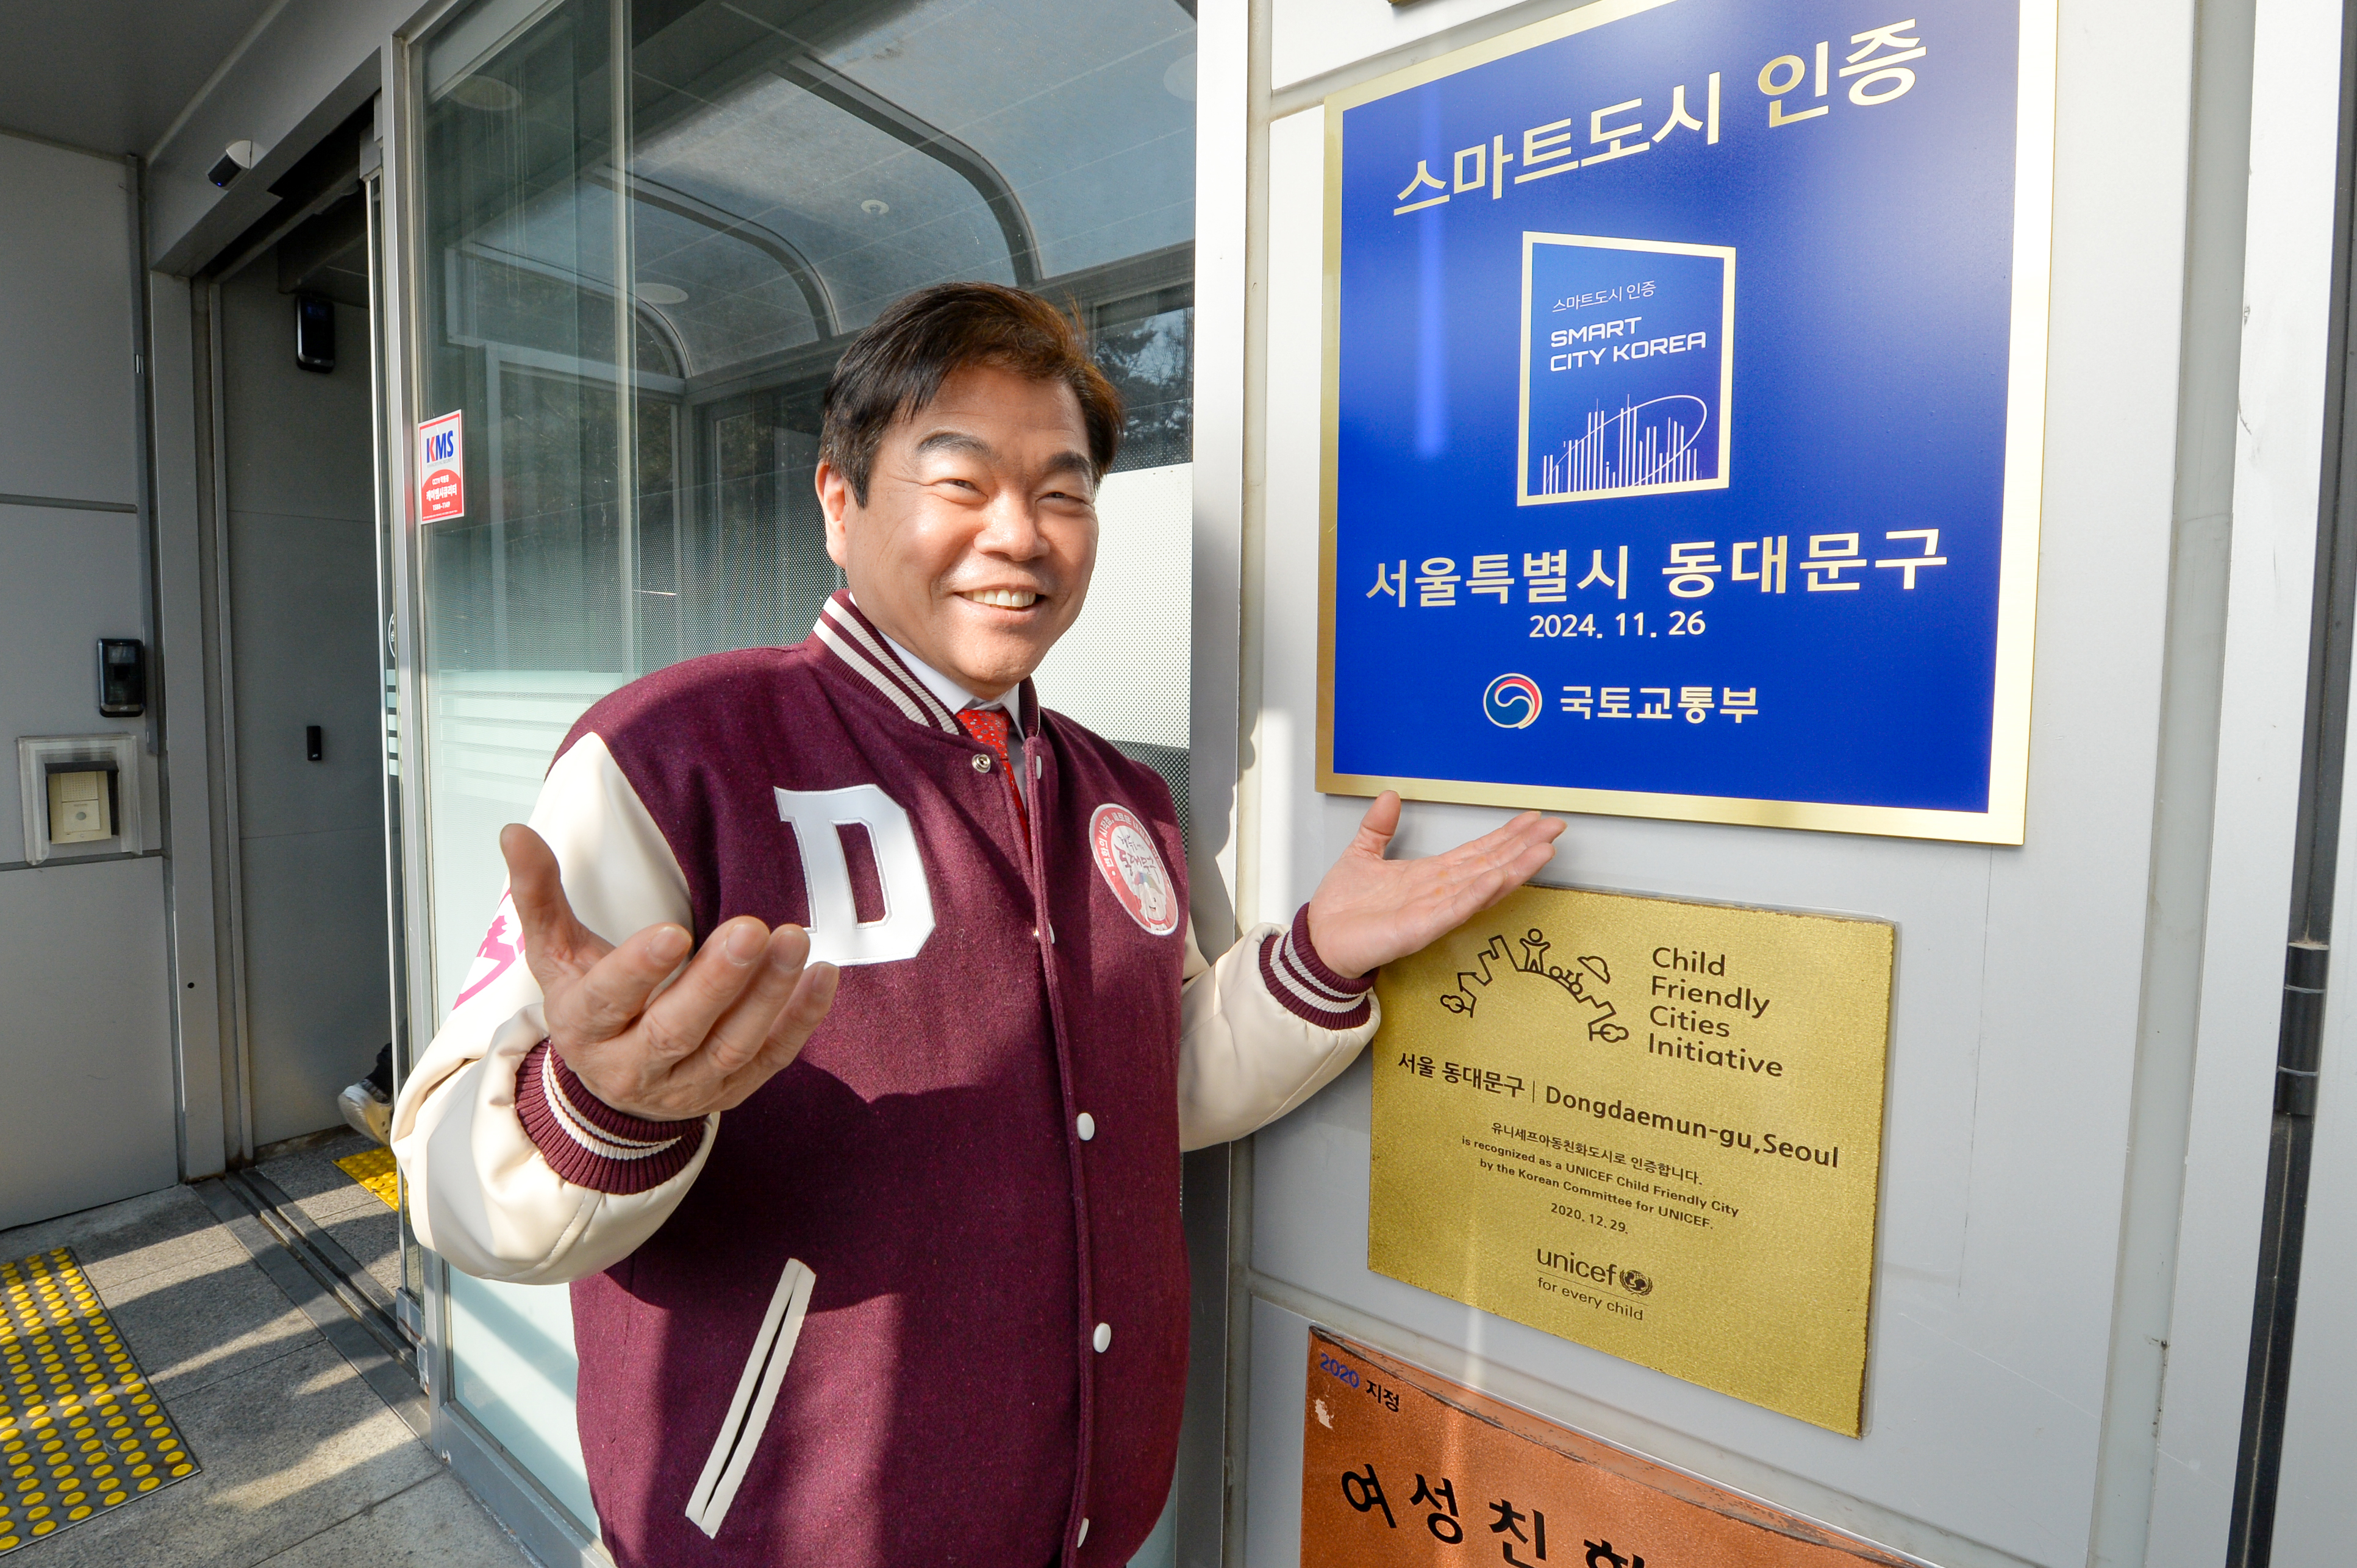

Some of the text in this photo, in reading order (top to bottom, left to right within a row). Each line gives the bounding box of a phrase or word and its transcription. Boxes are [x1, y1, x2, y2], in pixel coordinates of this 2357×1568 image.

[1393, 18, 1927, 216] 스마트도시 인증
[1552, 280, 1656, 312] 스마트도시 인증
[1550, 331, 1706, 372] CITY KOREA
[1551, 316, 1642, 347] SMART
[427, 430, 454, 463] KMS
[1365, 529, 1947, 608] 서울특별시 동대문구
[1529, 610, 1706, 639] 2024. 11. 26
[1560, 686, 1759, 724] 국토교통부
[773, 784, 936, 969] D
[1652, 946, 1726, 977] Child
[1651, 976, 1770, 1019] Friendly
[1650, 1005, 1730, 1037] Cities
[1398, 1052, 1436, 1078] 서울
[1442, 1061, 1525, 1099] 동대문구
[1648, 1033, 1784, 1077] Initiative
[1491, 1122, 1703, 1186] 유니세프아동친화도시로 인증합니다.
[1462, 1136, 1471, 1146] is
[1474, 1140, 1535, 1163] recognized
[1539, 1158, 1552, 1167] as
[1566, 1163, 1613, 1183] UNICEF
[1617, 1175, 1649, 1193] Child
[1654, 1186, 1707, 1210] Friendly
[1711, 1200, 1739, 1217] City
[1480, 1158, 1714, 1229] by the Korean Committee for UNICEF.
[1551, 1203, 1629, 1235] 2020. 12. 29.
[1537, 1248, 1617, 1285] unicef
[1538, 1277, 1643, 1321] for every child
[1320, 1353, 1400, 1413] 2020 지정
